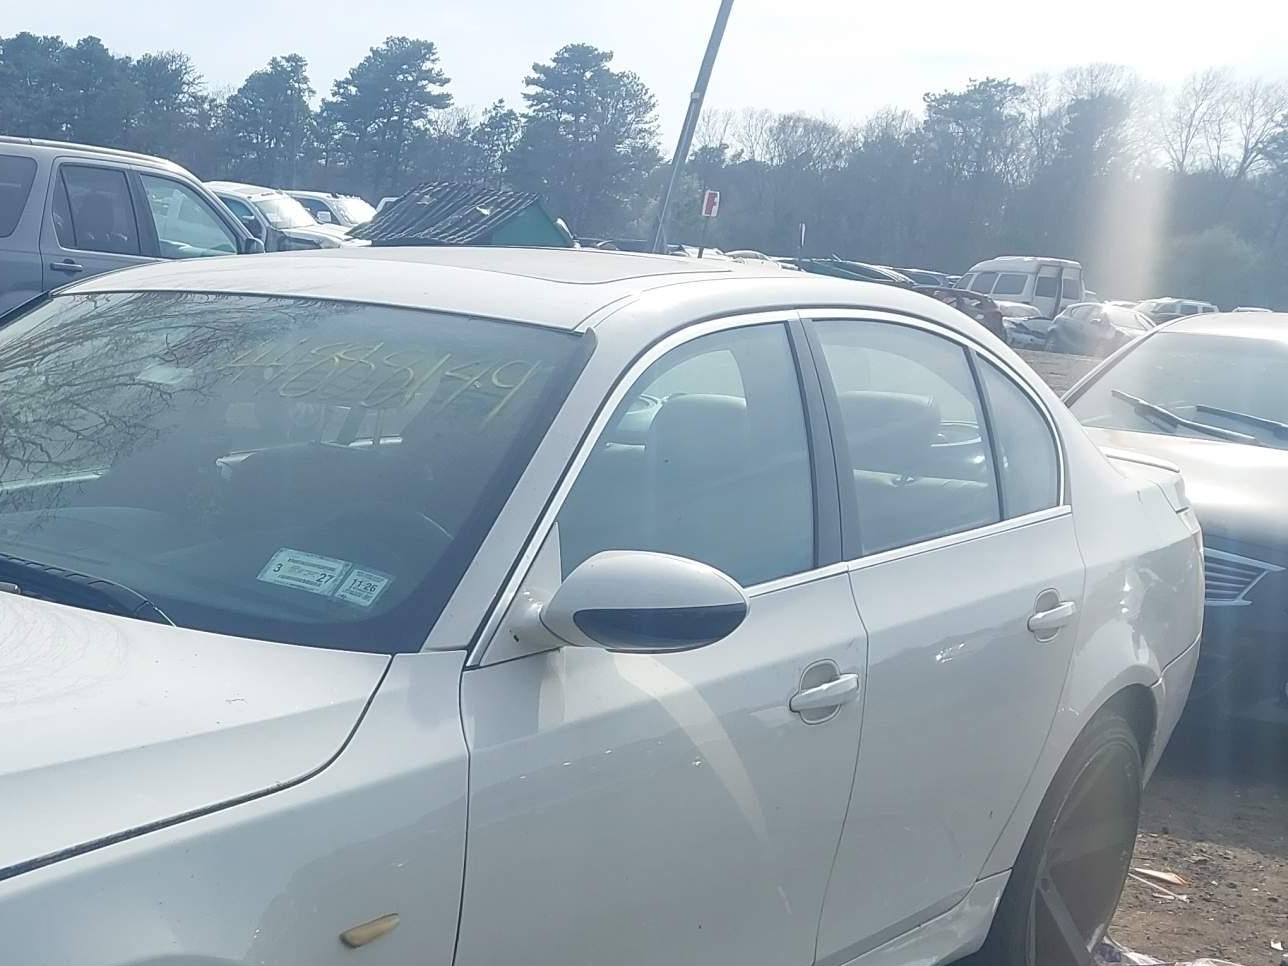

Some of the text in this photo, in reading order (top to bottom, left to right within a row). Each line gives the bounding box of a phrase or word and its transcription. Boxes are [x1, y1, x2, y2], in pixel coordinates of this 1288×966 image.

[704, 191, 718, 215] F
[273, 563, 283, 573] 3
[315, 573, 335, 585] 27
